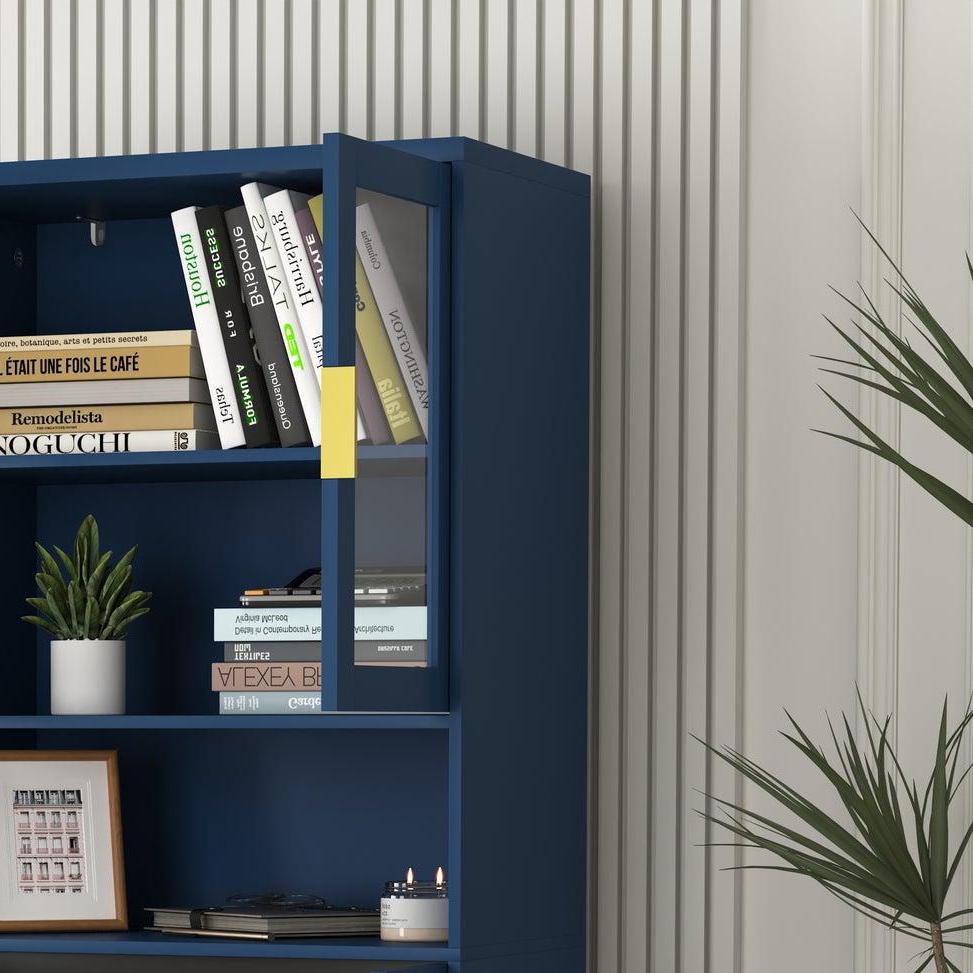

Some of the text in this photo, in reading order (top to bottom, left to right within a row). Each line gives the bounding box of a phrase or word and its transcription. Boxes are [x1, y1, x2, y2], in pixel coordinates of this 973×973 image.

[20, 338, 61, 349] botanique,
[63, 337, 80, 345] arts
[82, 337, 91, 345] et
[92, 335, 116, 346] petits
[118, 334, 148, 344] secrets
[5, 356, 37, 376] ÉTAIT
[40, 358, 62, 375] UNE
[66, 356, 91, 374] FOIS
[93, 356, 107, 373] LE
[110, 352, 139, 373] CAFÉ
[11, 410, 103, 426] Remodelista
